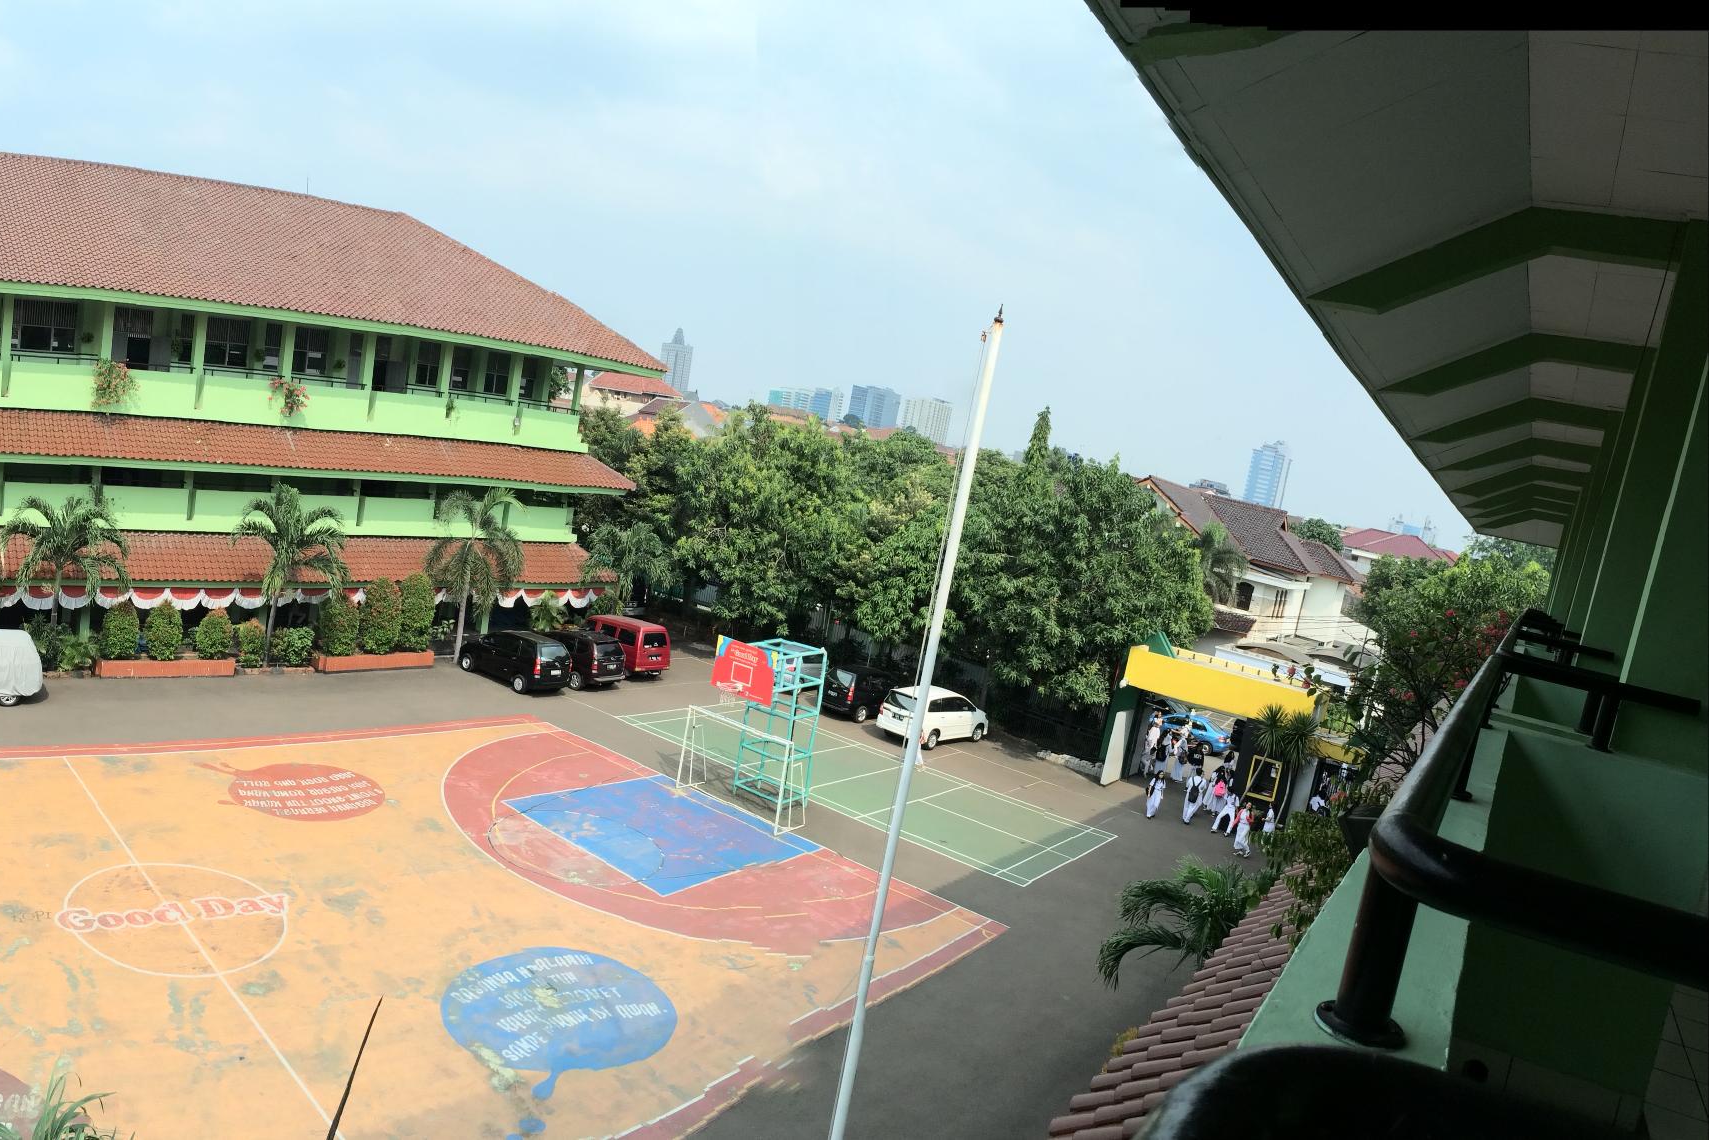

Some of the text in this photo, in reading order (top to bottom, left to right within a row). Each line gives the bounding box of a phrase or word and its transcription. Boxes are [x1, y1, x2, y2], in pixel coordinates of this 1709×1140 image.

[54, 900, 195, 932] Good
[191, 893, 290, 921] Day
[501, 1031, 548, 1062] SAMPE
